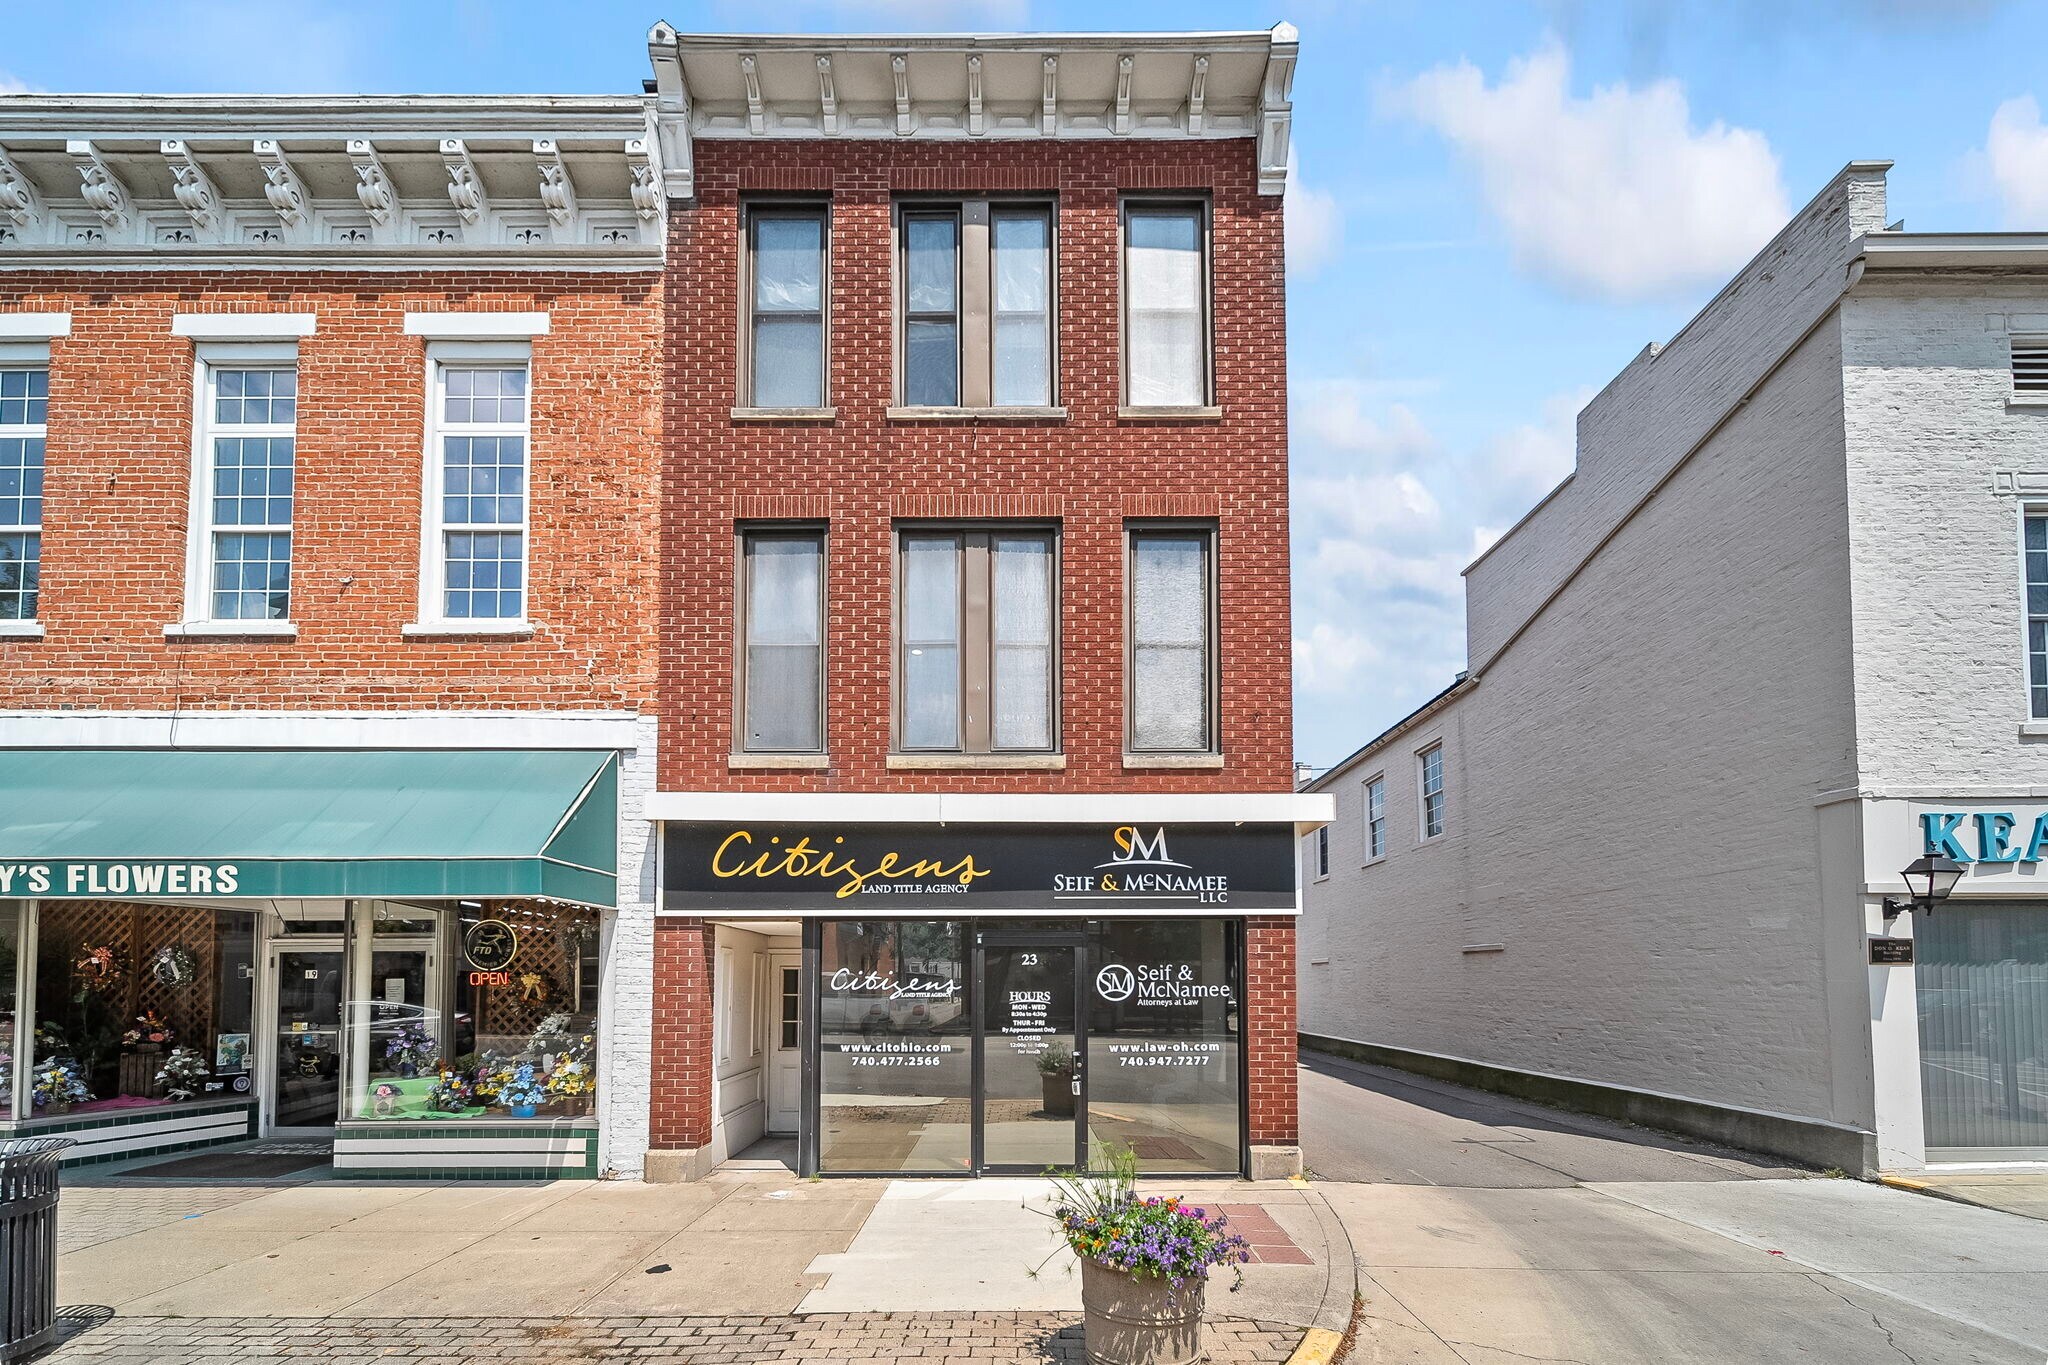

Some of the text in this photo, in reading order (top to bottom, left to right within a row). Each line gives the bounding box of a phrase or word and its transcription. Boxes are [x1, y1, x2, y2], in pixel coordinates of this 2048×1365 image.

[711, 830, 991, 899] Citizens
[67, 864, 239, 894] FLOWERS
[1053, 873, 1095, 892] SEIF
[1100, 873, 1120, 892] &
[861, 884, 970, 894] LAND TITLE AGENCY
[1200, 892, 1228, 903] LLC
[473, 946, 492, 955] FTD
[1021, 953, 1038, 966] 23
[307, 971, 317, 979] 19
[1137, 964, 1194, 981] Seif &
[469, 971, 508, 986] OPEN
[830, 967, 962, 1000] Citizens
[1137, 981, 1230, 998] McNamee
[1009, 991, 1051, 1001] HOURS
[1137, 999, 1173, 1007] Attorneys
[840, 1042, 951, 1053] www.cltohio.com
[1108, 1042, 1220, 1053] www.law-oh.com
[851, 1056, 941, 1066] 740.477.2566
[1119, 1056, 1210, 1067] 740.947.7277
